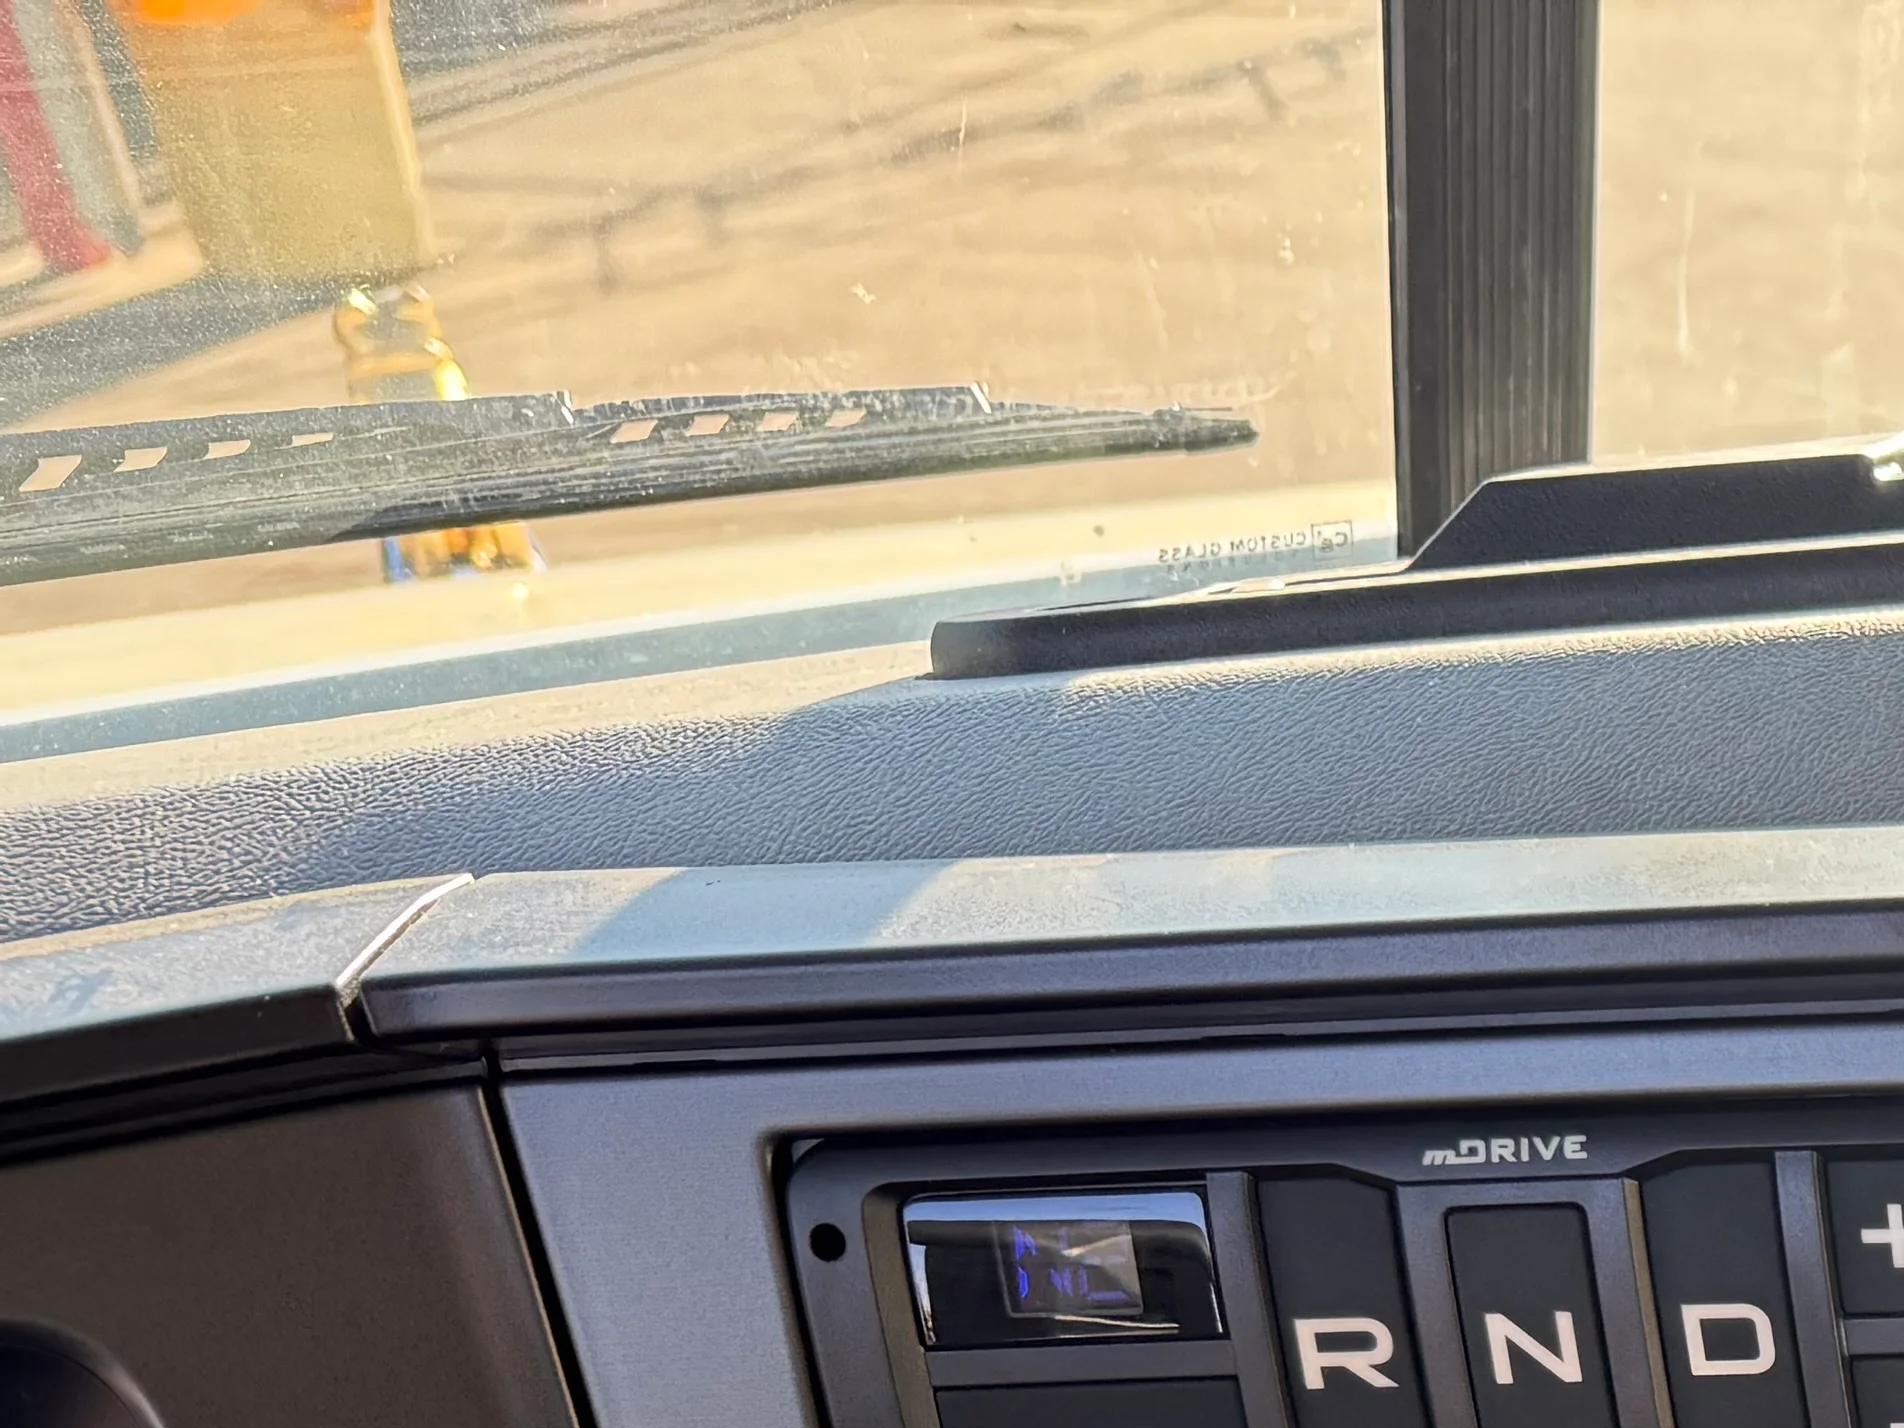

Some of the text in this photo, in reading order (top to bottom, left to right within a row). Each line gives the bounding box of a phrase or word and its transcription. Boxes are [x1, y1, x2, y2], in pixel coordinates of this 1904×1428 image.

[1294, 1317, 1399, 1389] R
[1483, 1310, 1583, 1384] N
[1680, 1303, 1776, 1376] D
